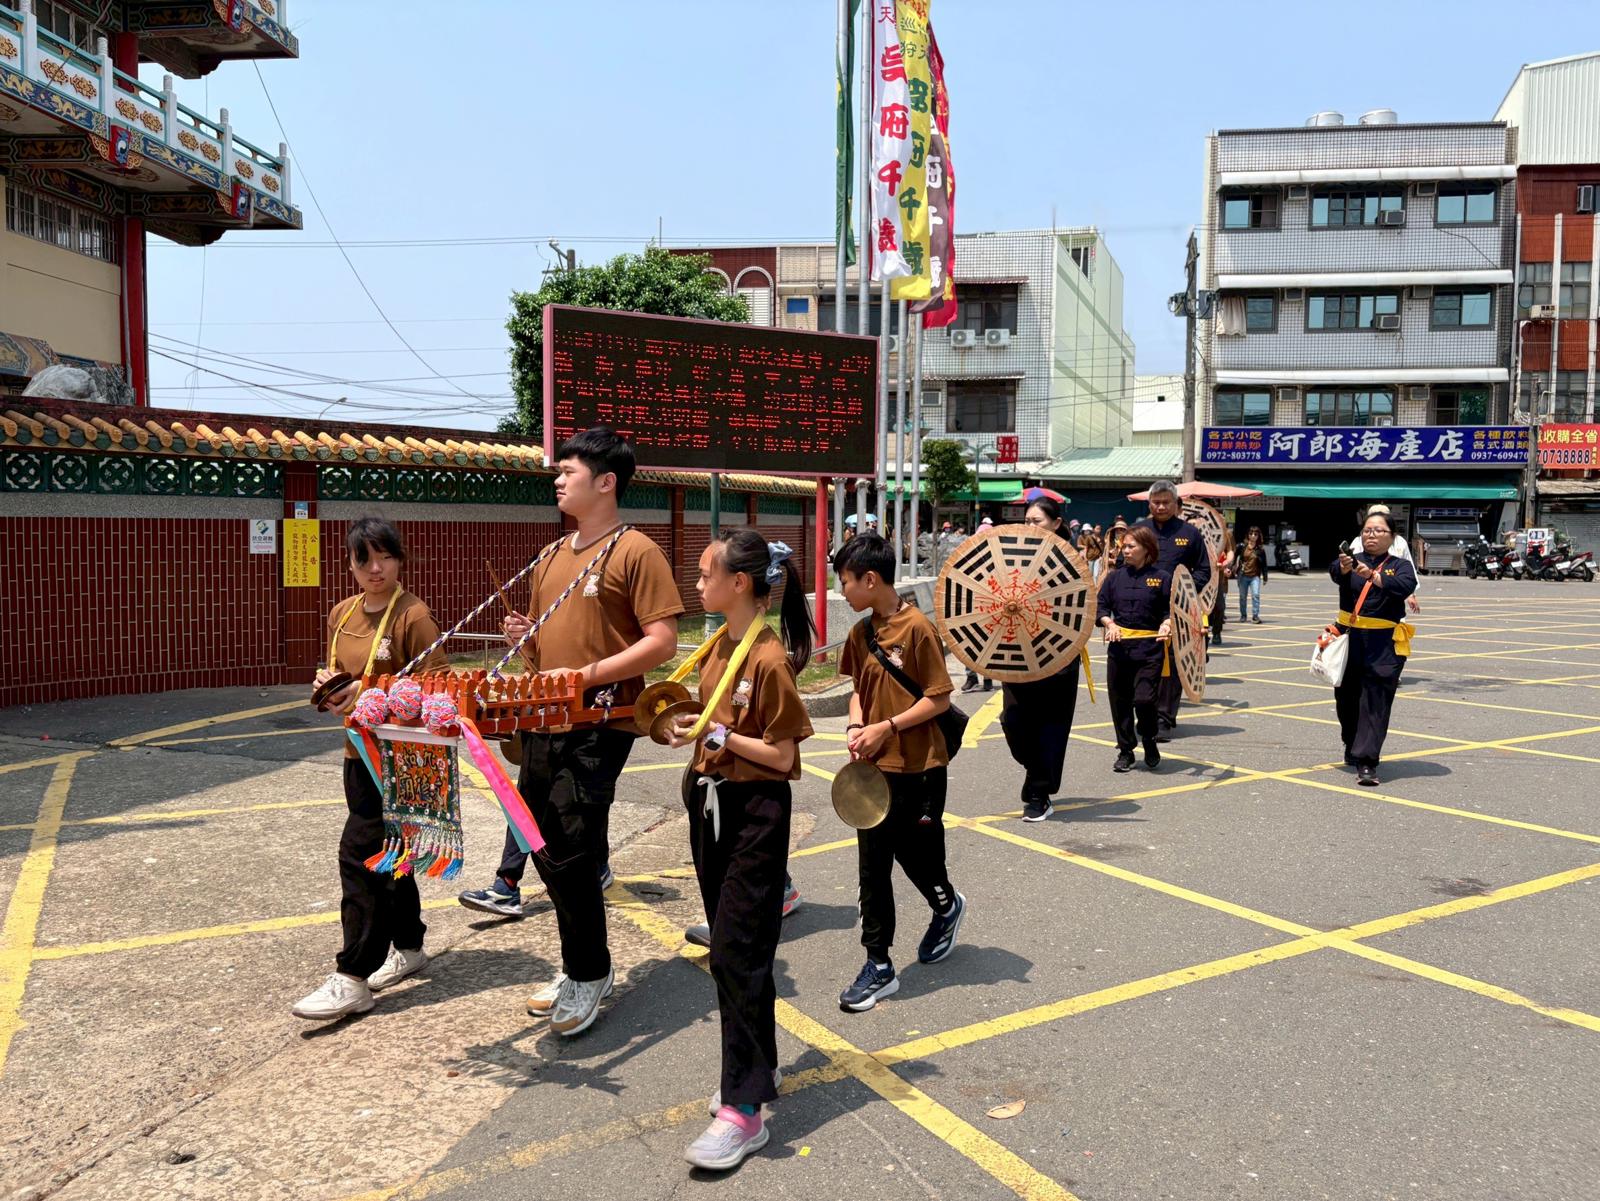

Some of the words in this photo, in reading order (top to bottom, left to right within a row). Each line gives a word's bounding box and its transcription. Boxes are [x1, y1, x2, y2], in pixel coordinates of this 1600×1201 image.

[1208, 431, 1262, 440] 各式小吃
[1268, 430, 1464, 461] 阿郎海產店
[1206, 451, 1262, 460] 0972-803778
[1471, 451, 1529, 460] 0937-609470
